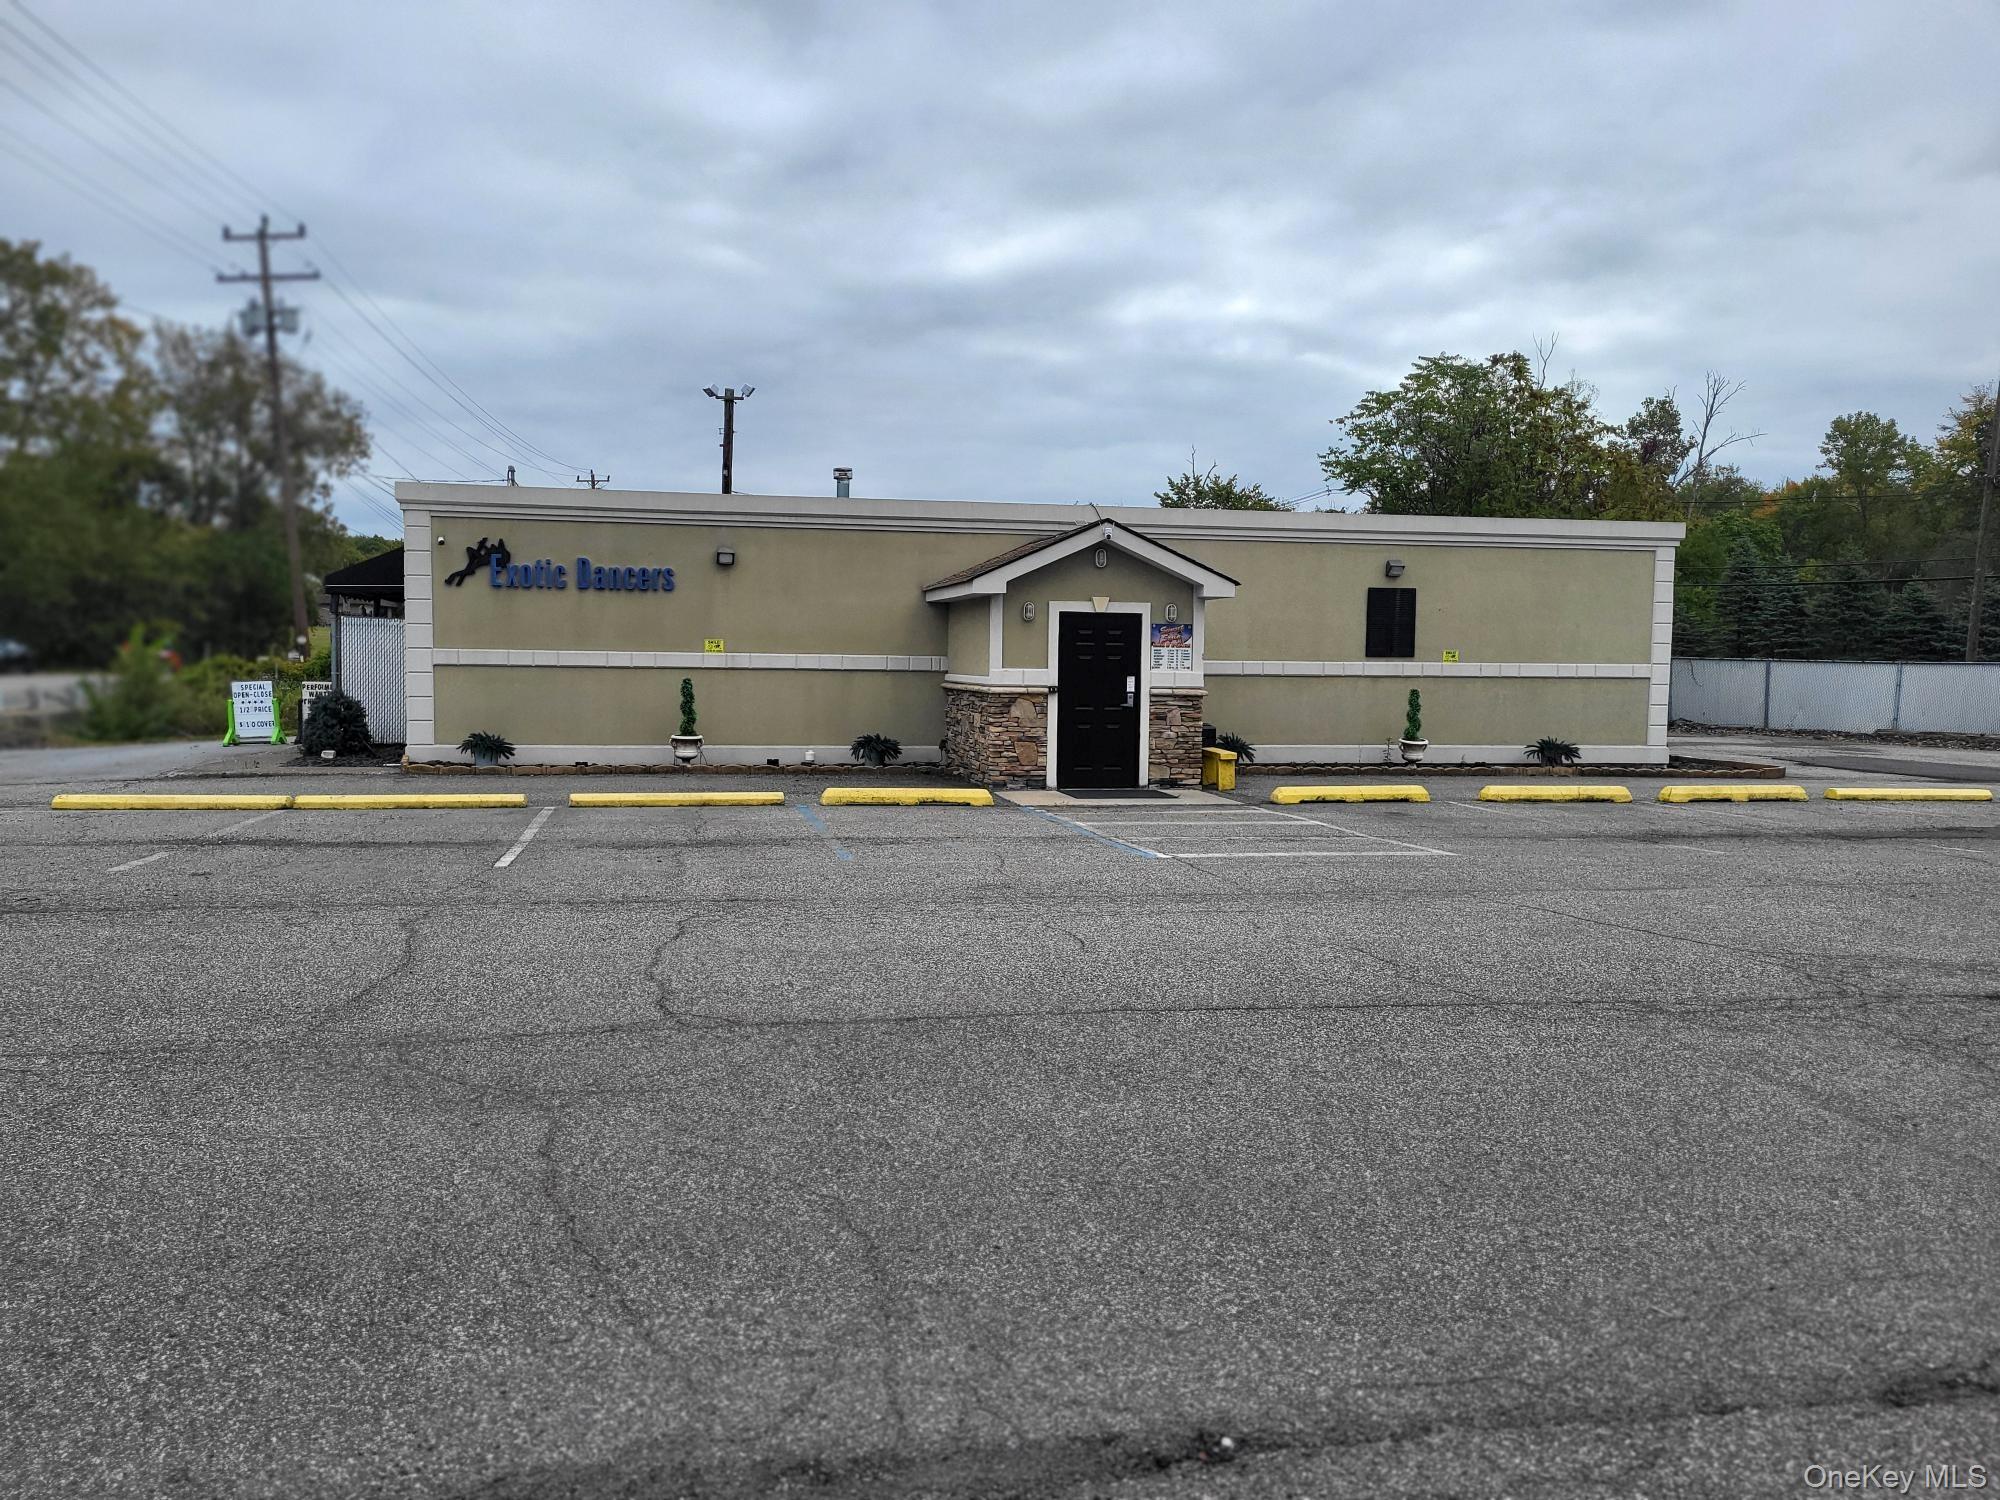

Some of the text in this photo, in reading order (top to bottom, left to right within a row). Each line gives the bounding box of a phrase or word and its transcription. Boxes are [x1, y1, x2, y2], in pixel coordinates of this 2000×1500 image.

[490, 553, 675, 592] Exotic Dancers
[240, 683, 266, 691] SPECIAL
[233, 690, 272, 699] OPEN-CLOSE
[254, 705, 272, 713] PRICE
